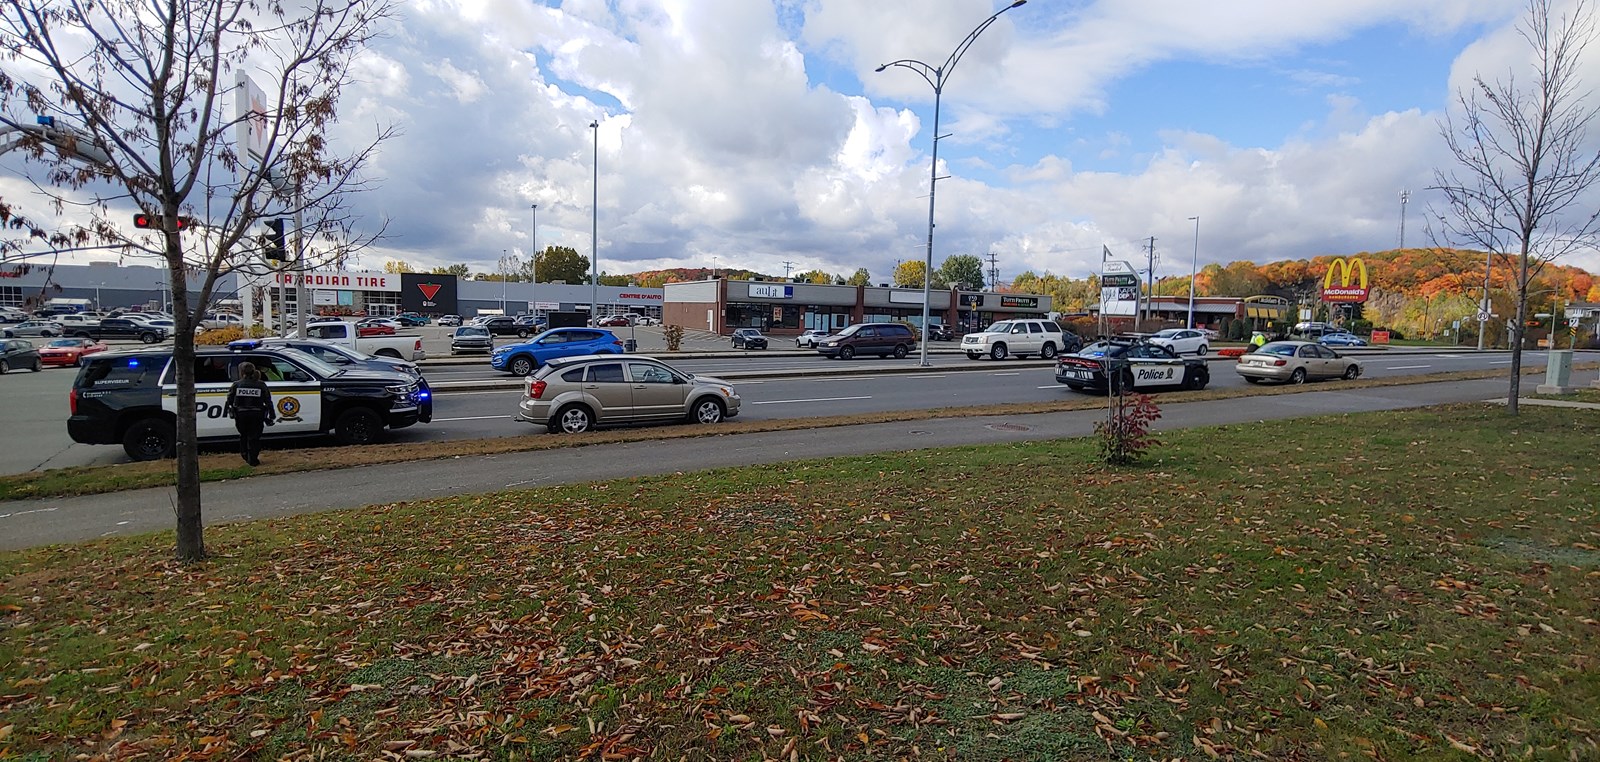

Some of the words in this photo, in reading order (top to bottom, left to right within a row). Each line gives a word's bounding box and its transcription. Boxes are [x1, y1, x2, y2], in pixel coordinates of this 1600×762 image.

[276, 274, 350, 286] CAADIAN
[356, 276, 386, 287] TIRE
[1138, 369, 1164, 379] Police
[238, 388, 259, 396] POLICE
